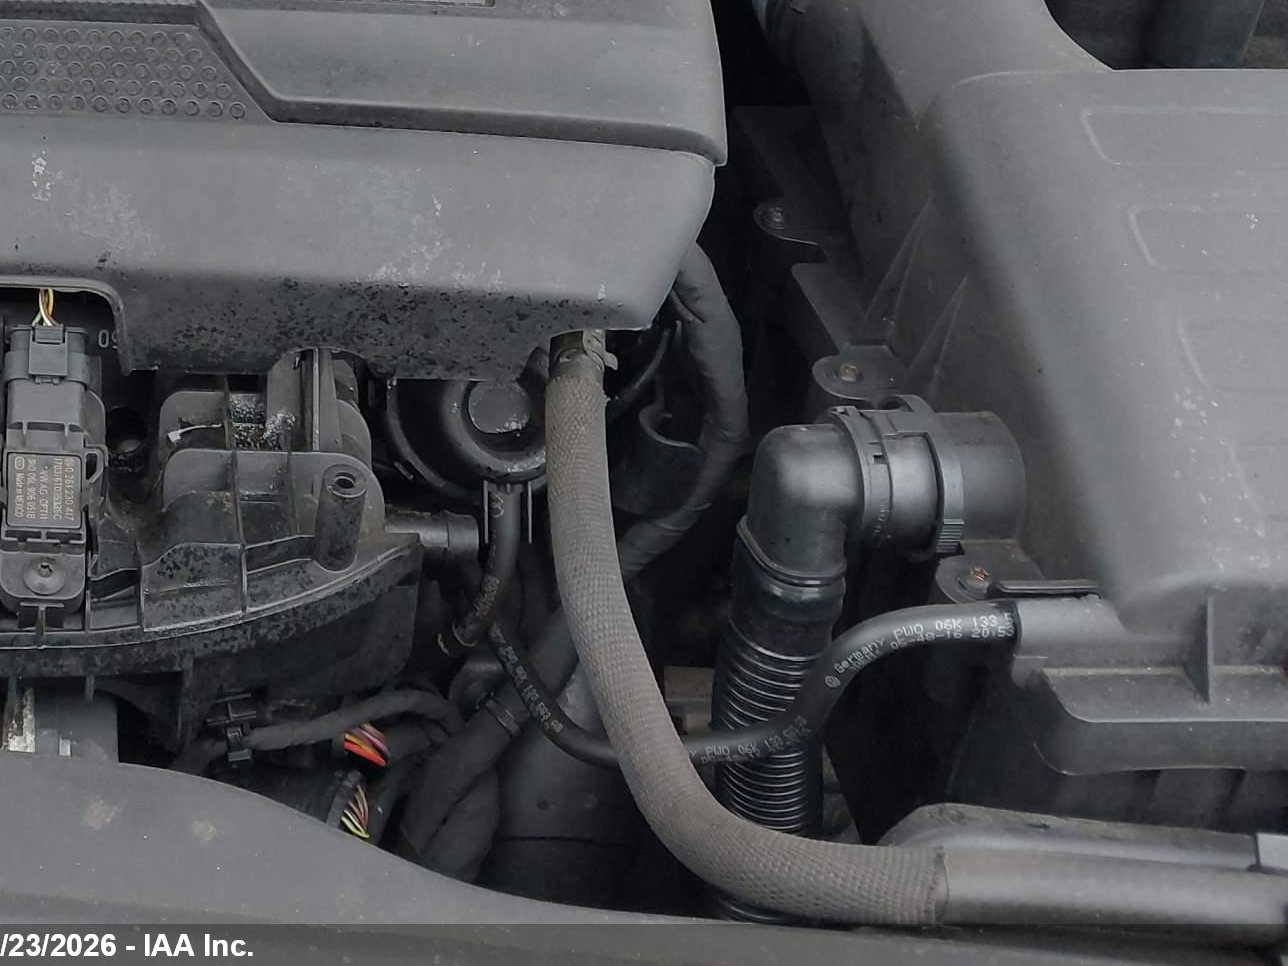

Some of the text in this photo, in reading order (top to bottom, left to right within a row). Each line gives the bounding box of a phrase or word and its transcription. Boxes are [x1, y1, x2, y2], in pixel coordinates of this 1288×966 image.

[834, 636, 886, 674] Germany
[935, 618, 962, 632] 06K
[972, 614, 998, 628] 133
